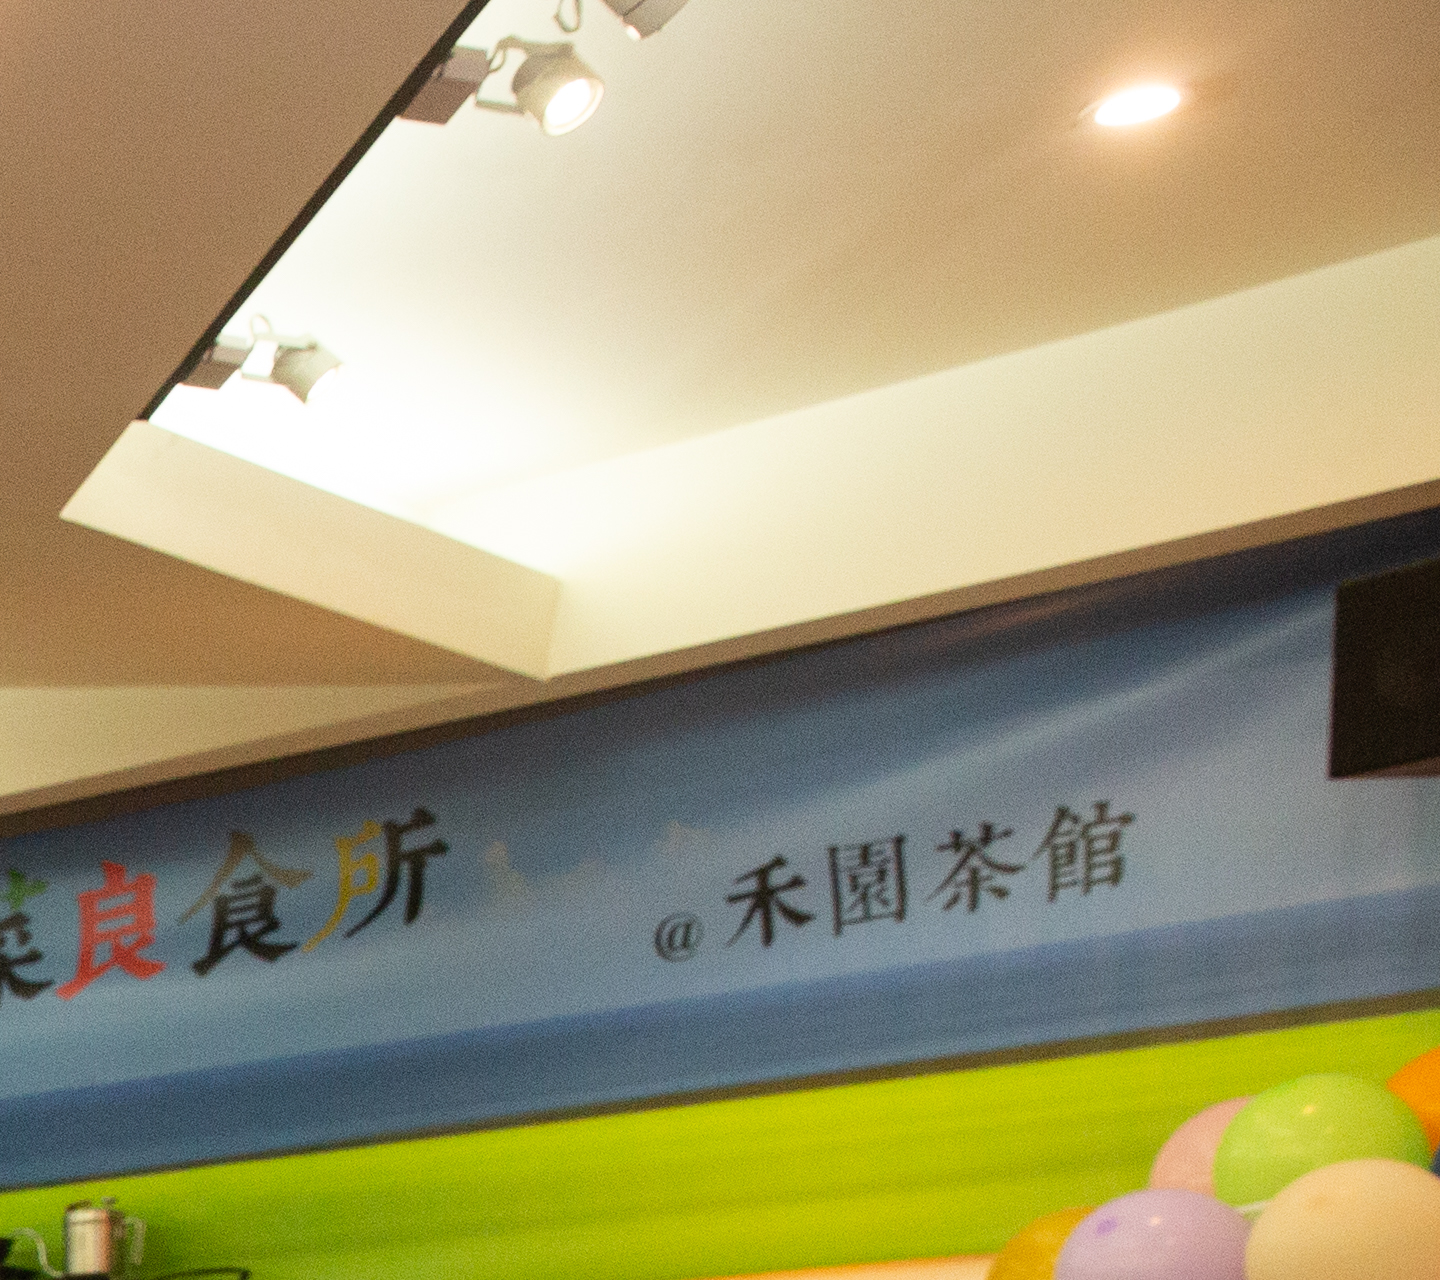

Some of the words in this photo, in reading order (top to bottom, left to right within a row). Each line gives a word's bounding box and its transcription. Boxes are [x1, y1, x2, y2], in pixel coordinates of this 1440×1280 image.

[653, 912, 704, 963] @
[726, 799, 1136, 948] 禾園茶館
